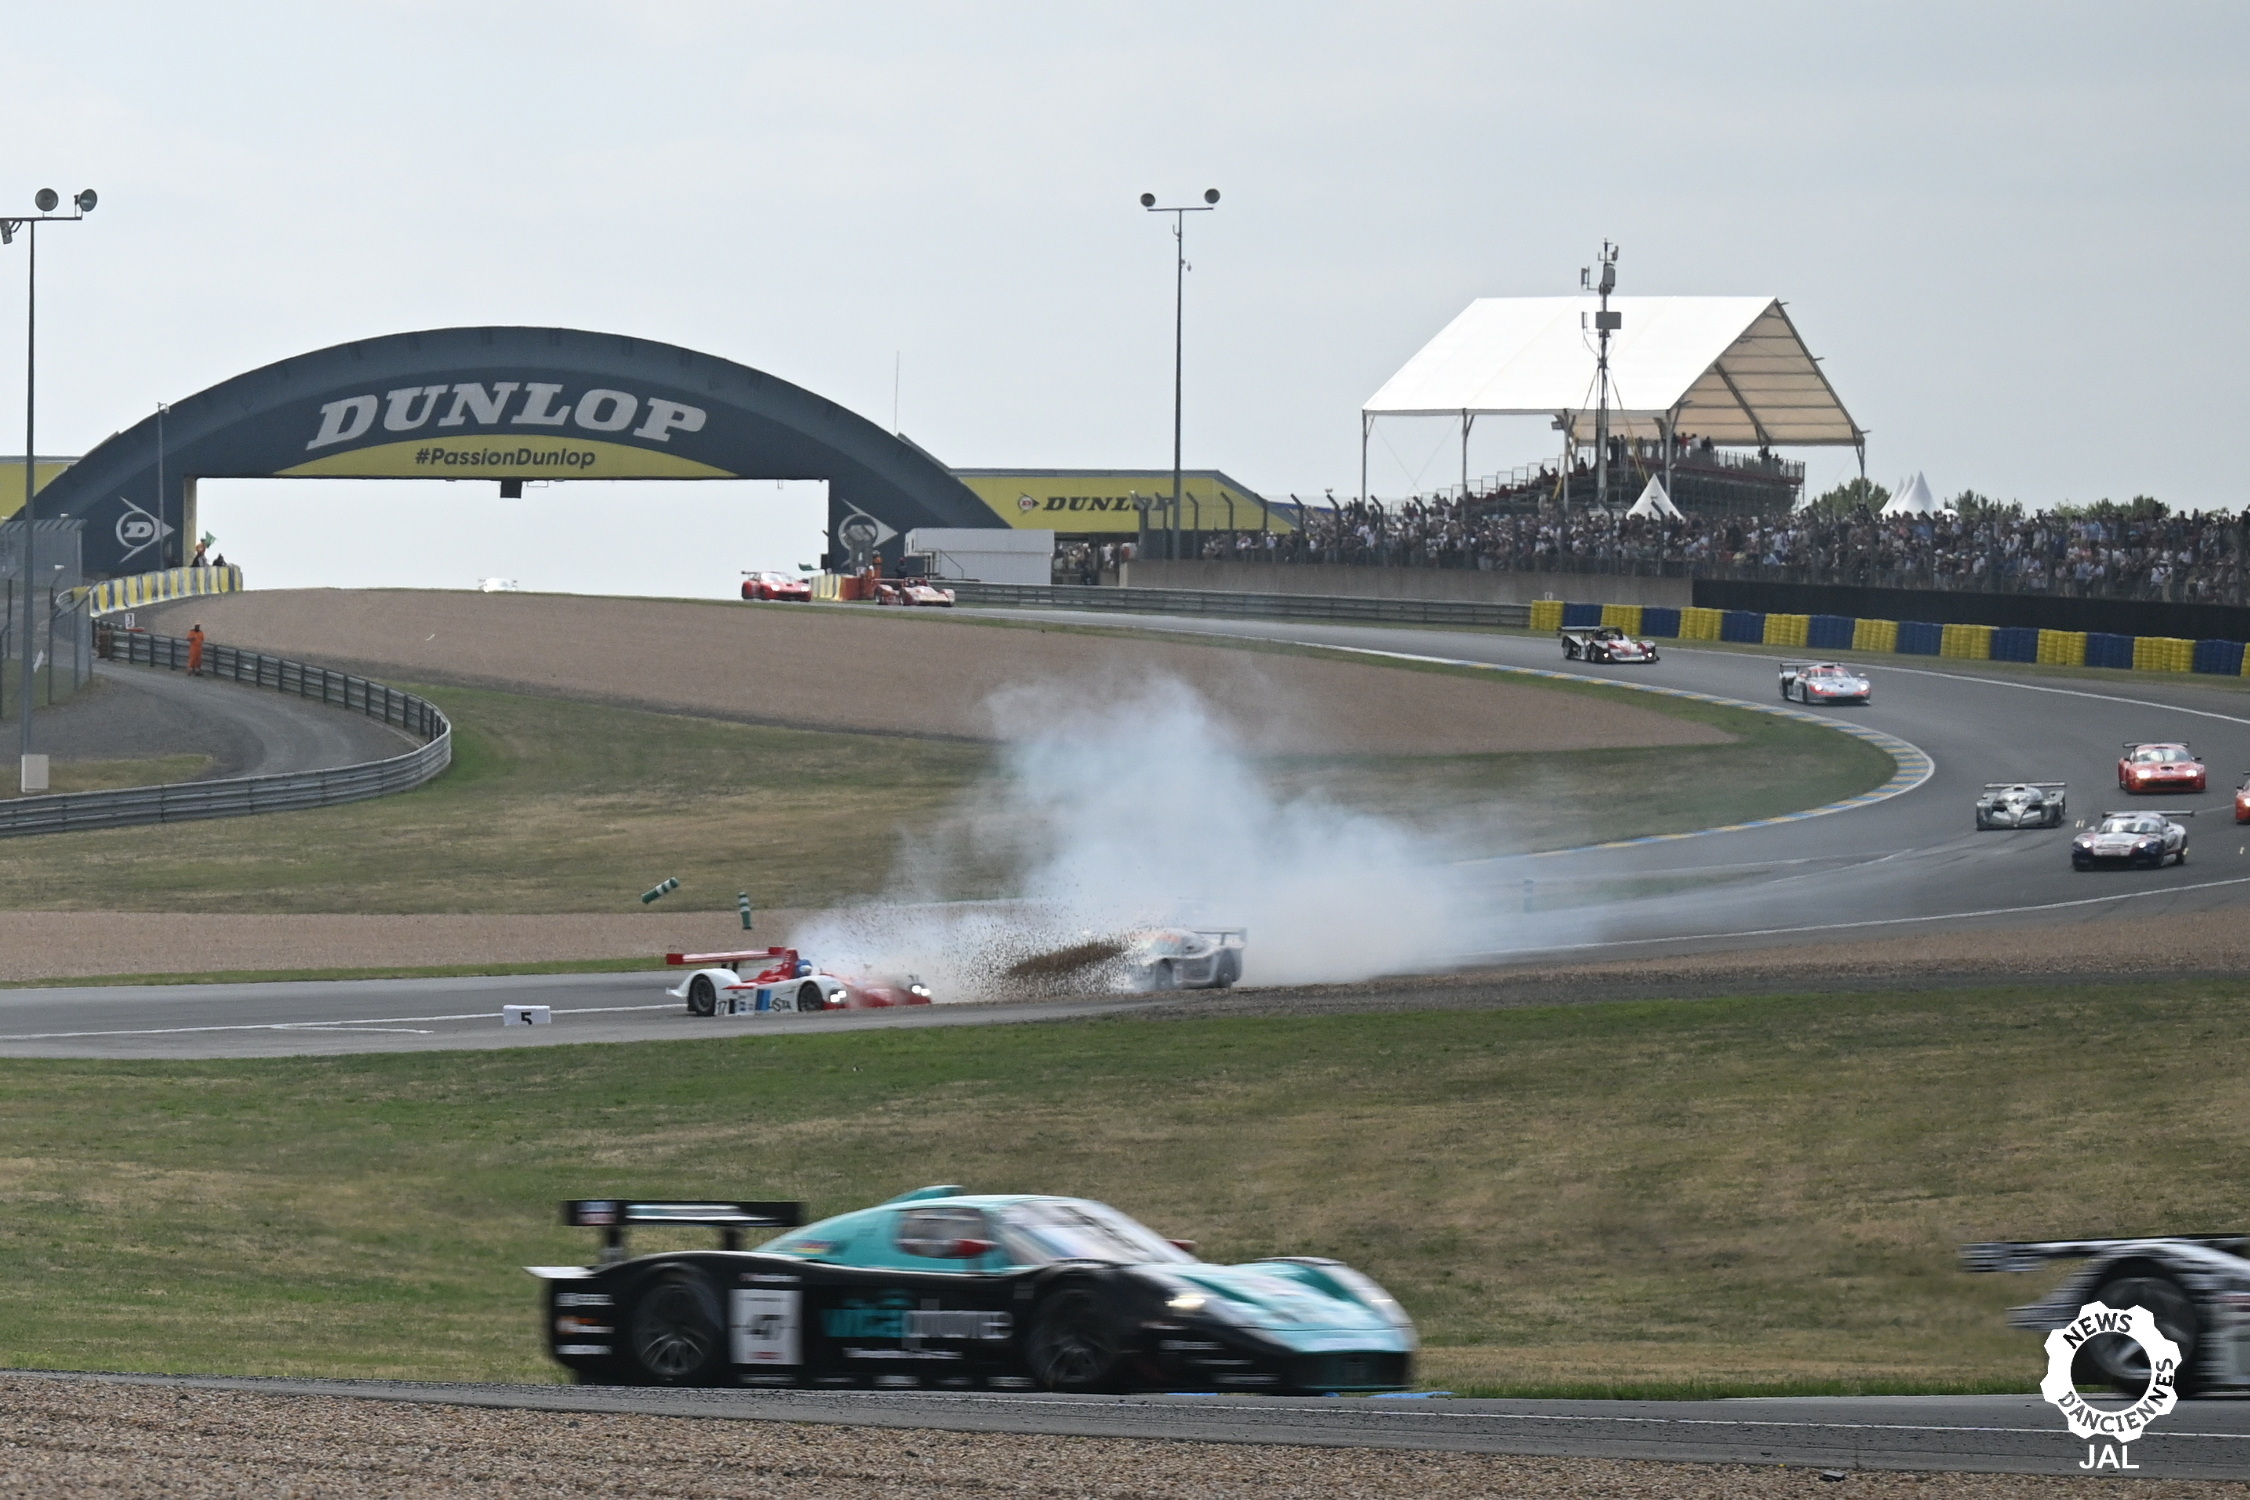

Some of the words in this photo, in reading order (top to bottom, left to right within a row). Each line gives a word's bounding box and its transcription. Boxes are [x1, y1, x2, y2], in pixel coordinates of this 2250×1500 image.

[305, 381, 707, 451] DUNLOP
[415, 447, 596, 469] #PassionDunlop
[124, 522, 154, 538] D
[521, 1011, 532, 1025] 5
